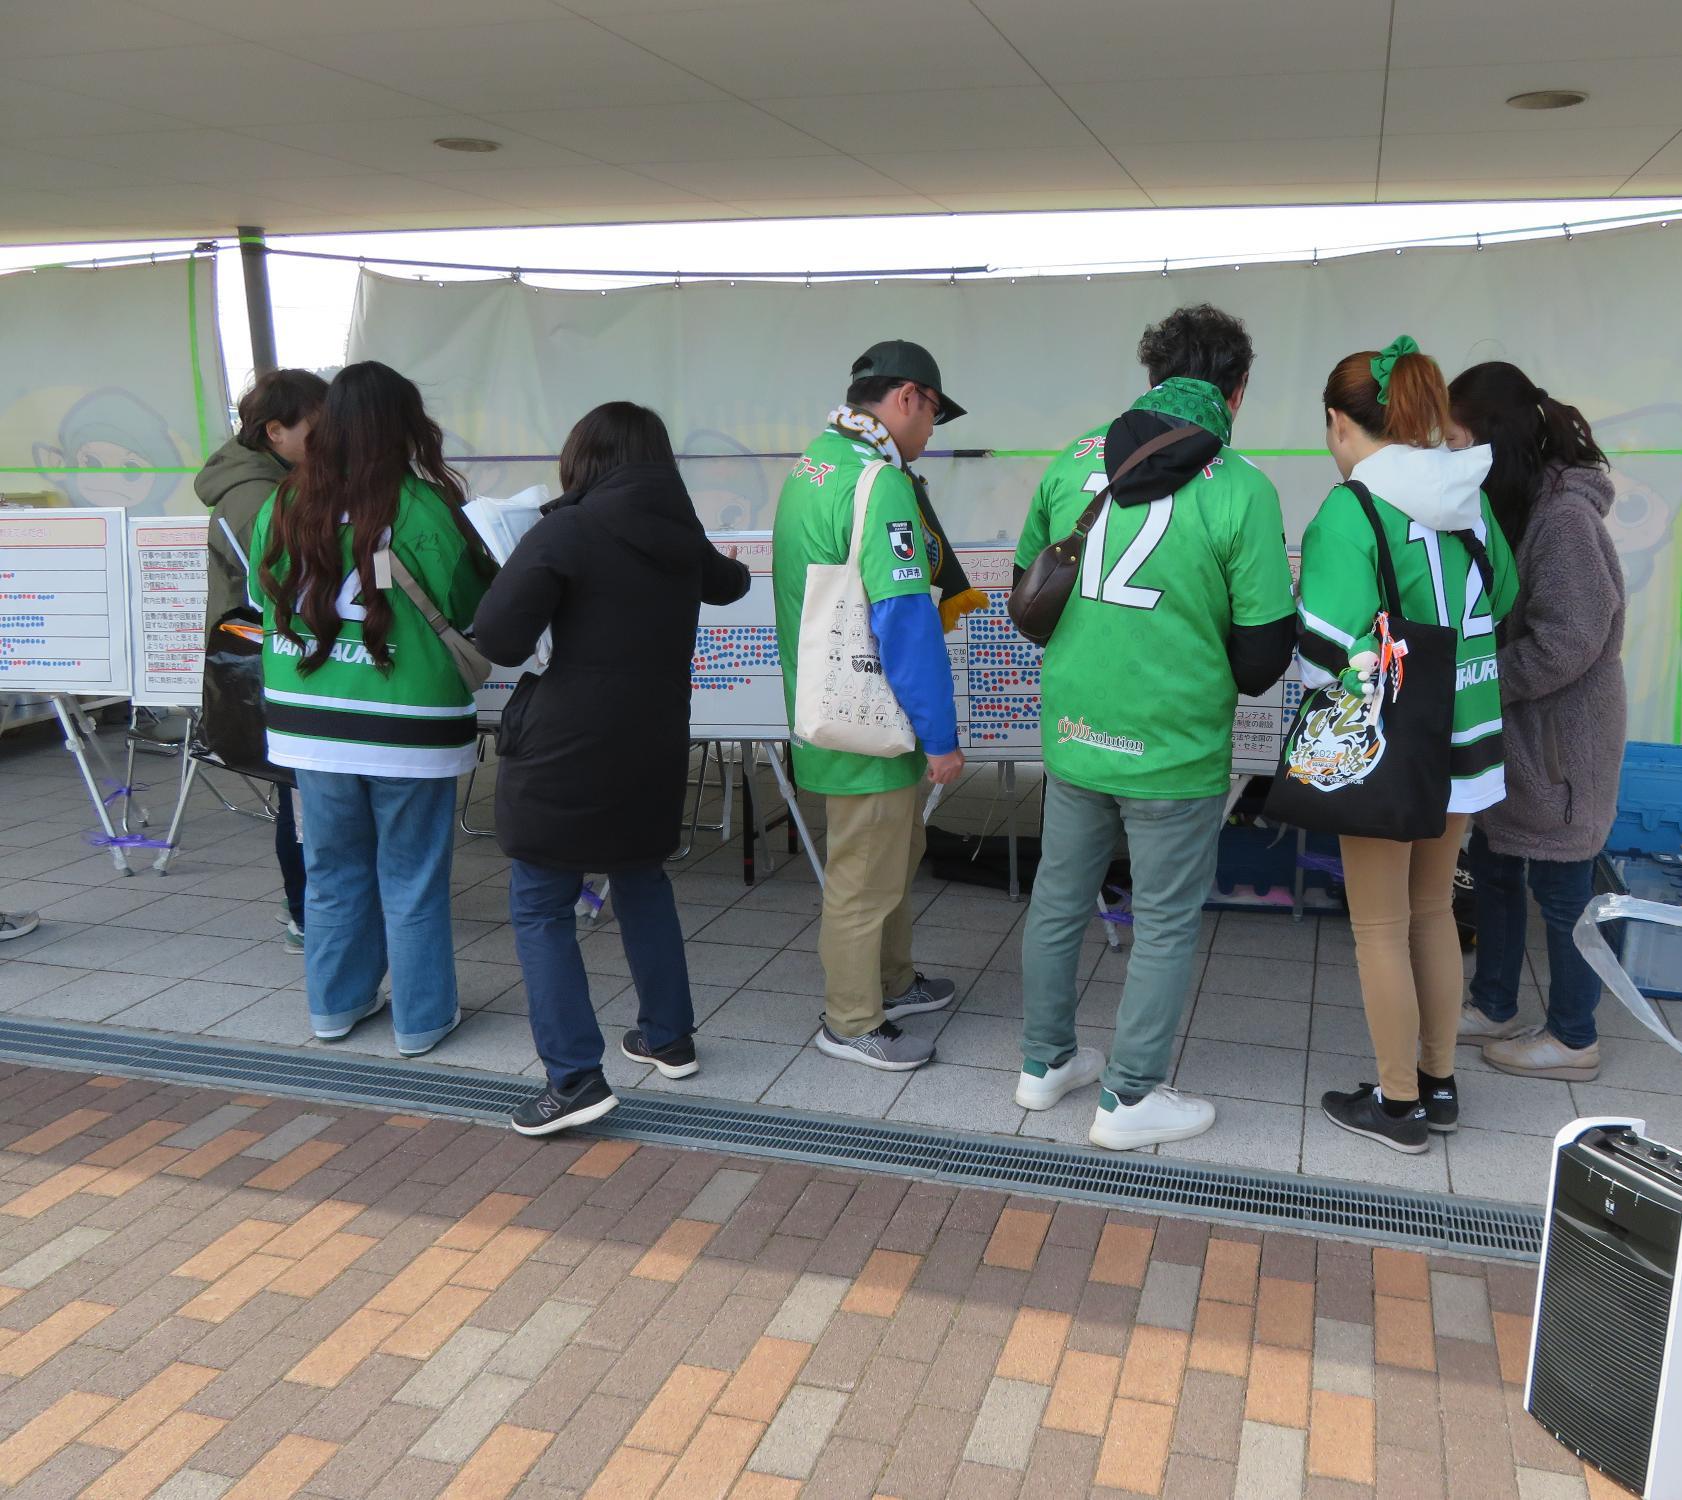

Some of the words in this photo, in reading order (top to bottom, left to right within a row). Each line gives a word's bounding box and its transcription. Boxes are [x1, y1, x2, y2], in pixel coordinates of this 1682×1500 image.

[898, 568, 921, 580] 八戸市
[1080, 470, 1175, 611] 12
[1406, 518, 1494, 641] 12
[1313, 749, 1337, 759] 2025
